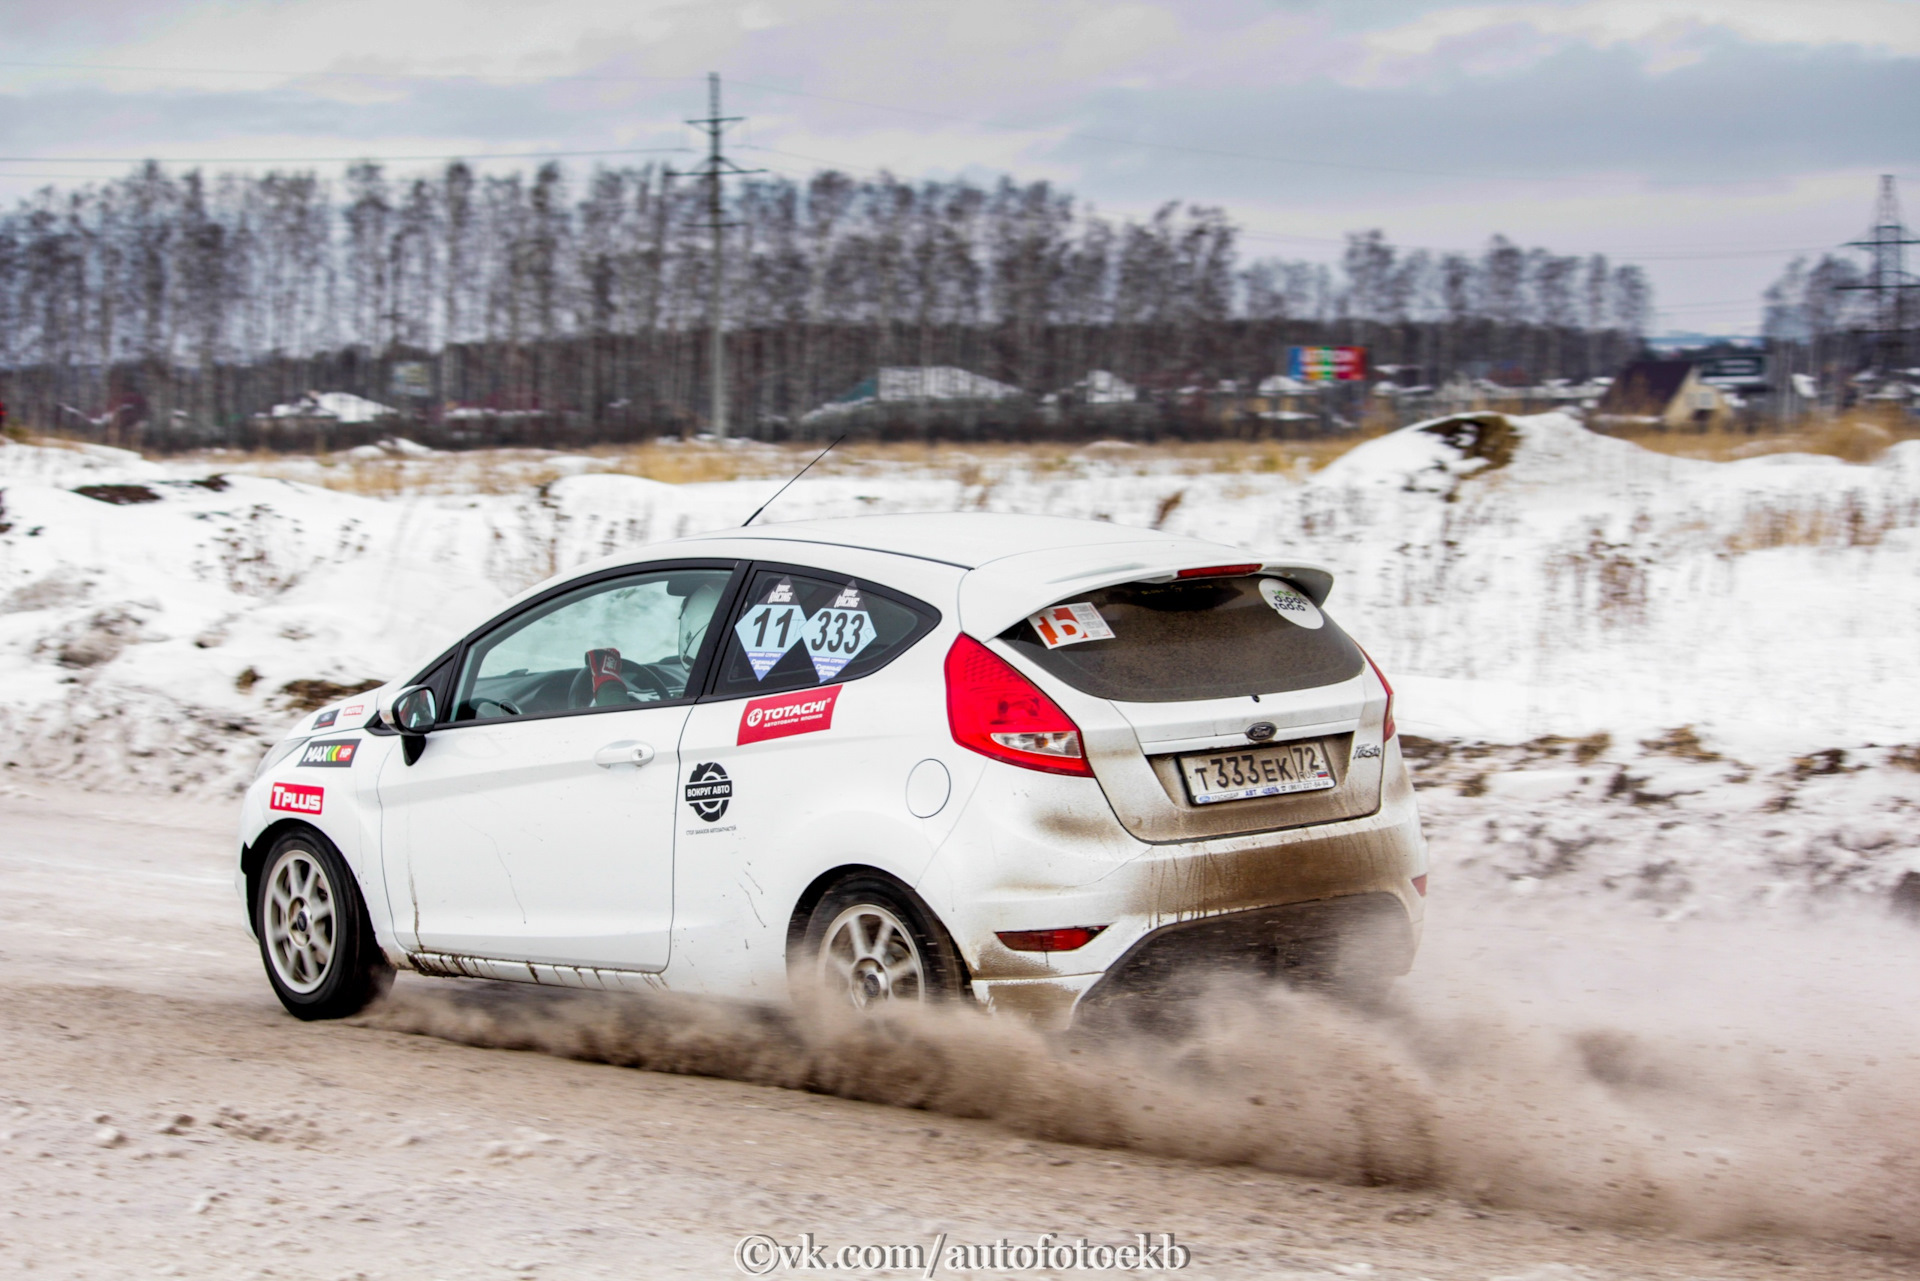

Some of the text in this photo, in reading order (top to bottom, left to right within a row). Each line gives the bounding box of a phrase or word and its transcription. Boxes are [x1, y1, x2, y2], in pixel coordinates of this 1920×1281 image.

[753, 608, 795, 648] 11
[811, 611, 865, 654] 333
[763, 700, 827, 721] TOTACHI
[303, 746, 328, 762] MAX
[1292, 747, 1320, 771] 72
[1299, 771, 1317, 780] RUS
[687, 785, 730, 797] ВОКРУГ АВТО
